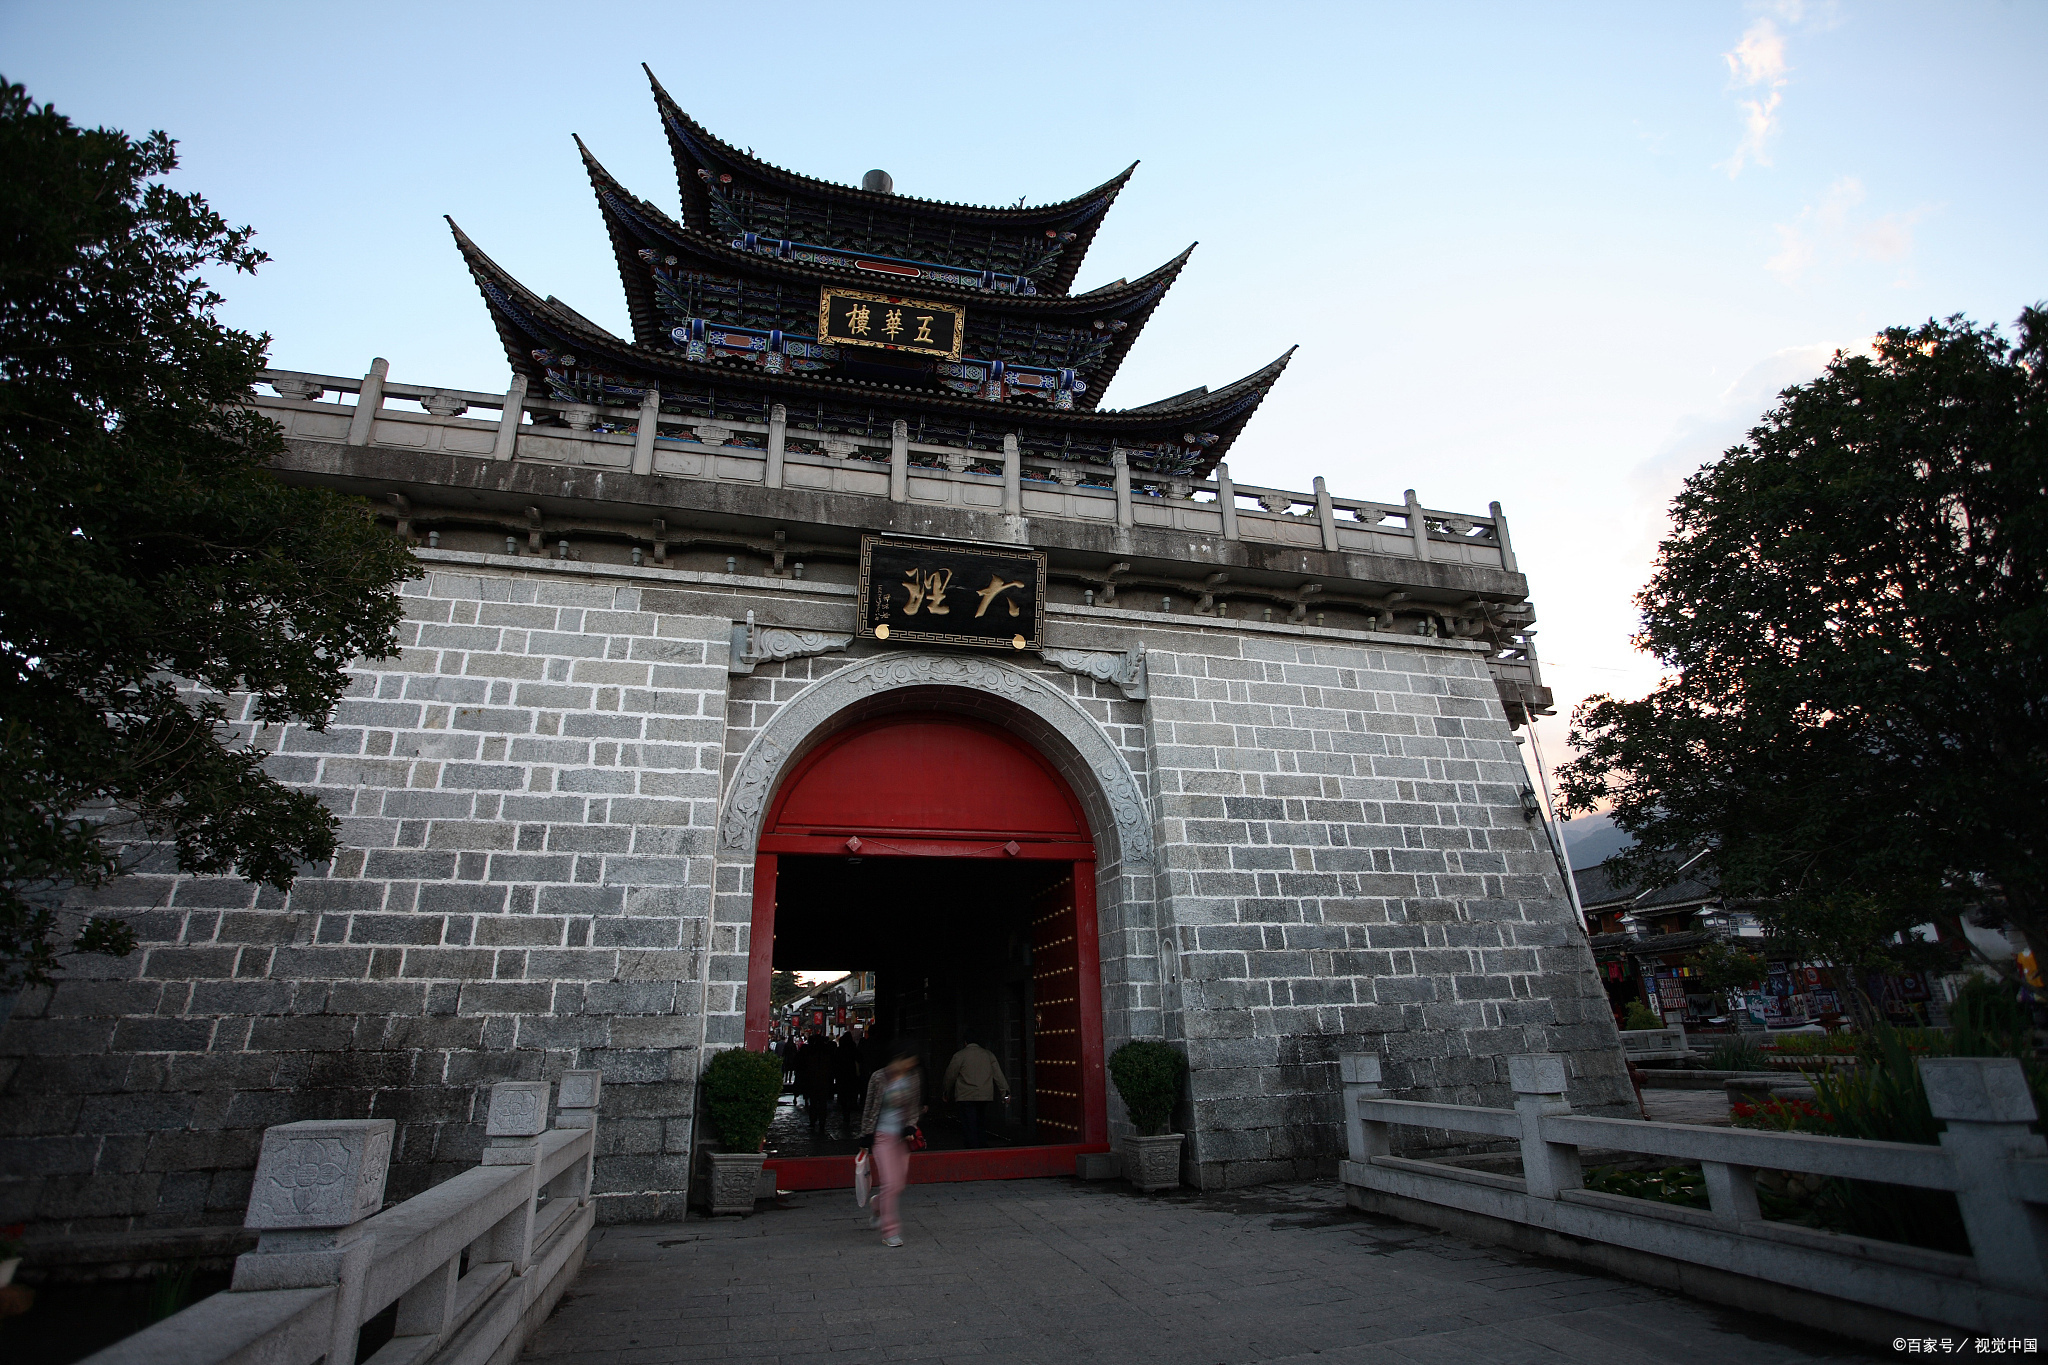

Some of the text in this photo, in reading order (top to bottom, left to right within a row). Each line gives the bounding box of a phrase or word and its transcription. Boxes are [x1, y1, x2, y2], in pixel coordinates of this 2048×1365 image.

[845, 303, 934, 344] 五華樓
[901, 567, 1025, 619] 大理
